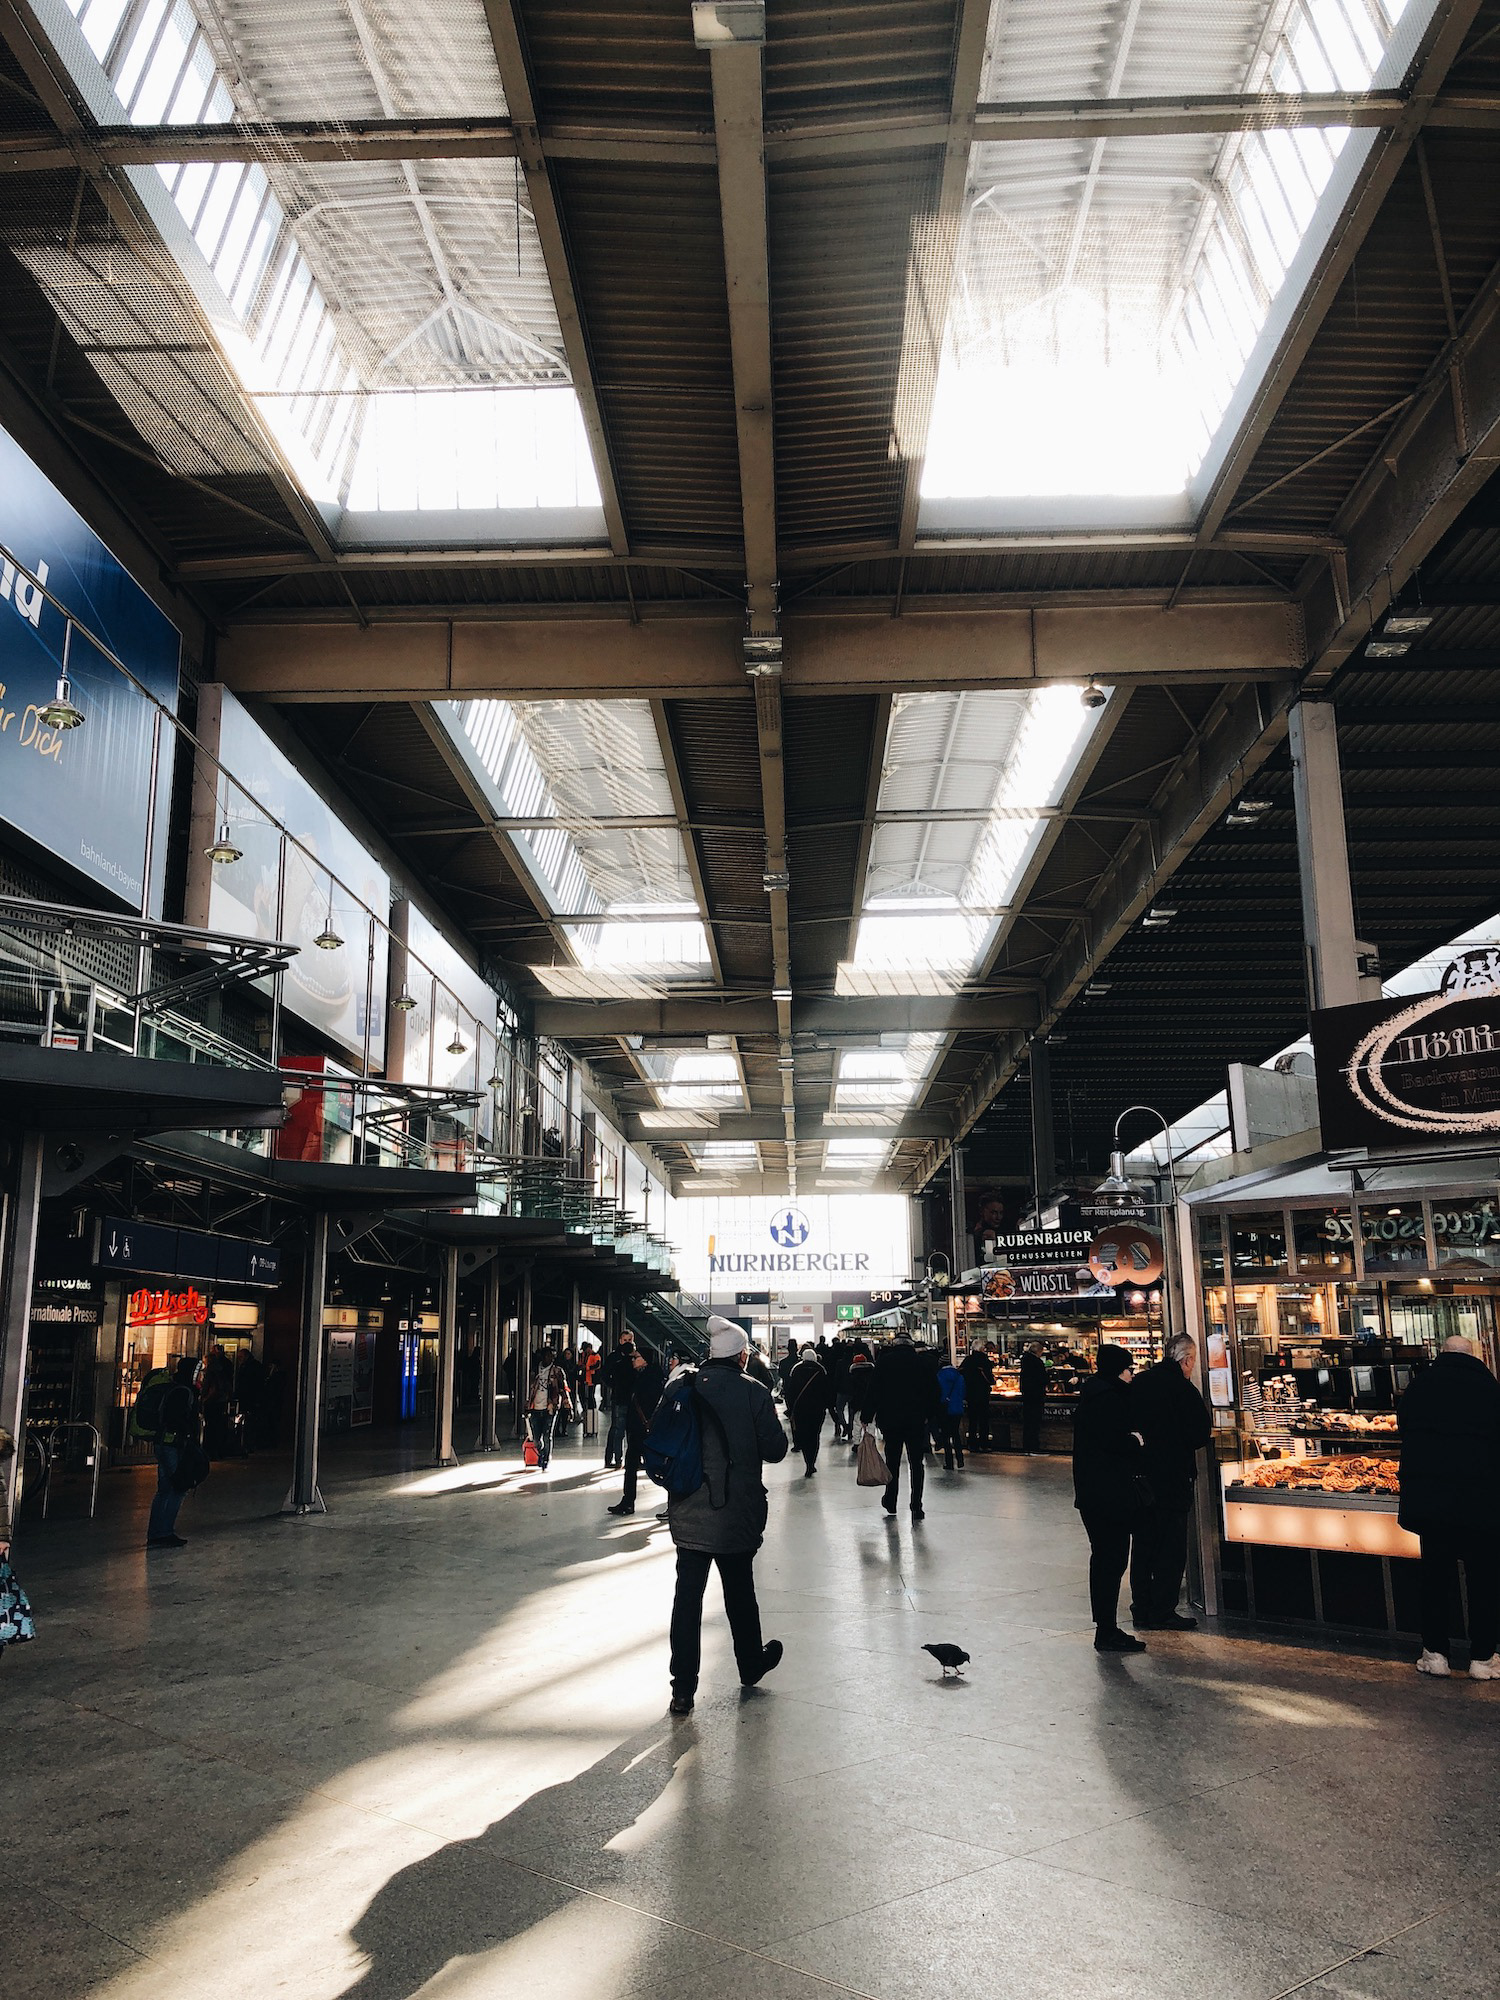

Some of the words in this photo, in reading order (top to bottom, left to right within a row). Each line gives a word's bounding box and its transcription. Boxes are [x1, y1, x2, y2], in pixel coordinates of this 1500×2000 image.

[710, 1252, 870, 1273] NÜRNBERGER
[1009, 1250, 1083, 1261] GENUSSWELTEN
[1020, 1271, 1072, 1293] WÜRSTL
[130, 1286, 200, 1319] Ditsch
[870, 1291, 892, 1302] 5-10
[73, 1305, 98, 1323] Presse
